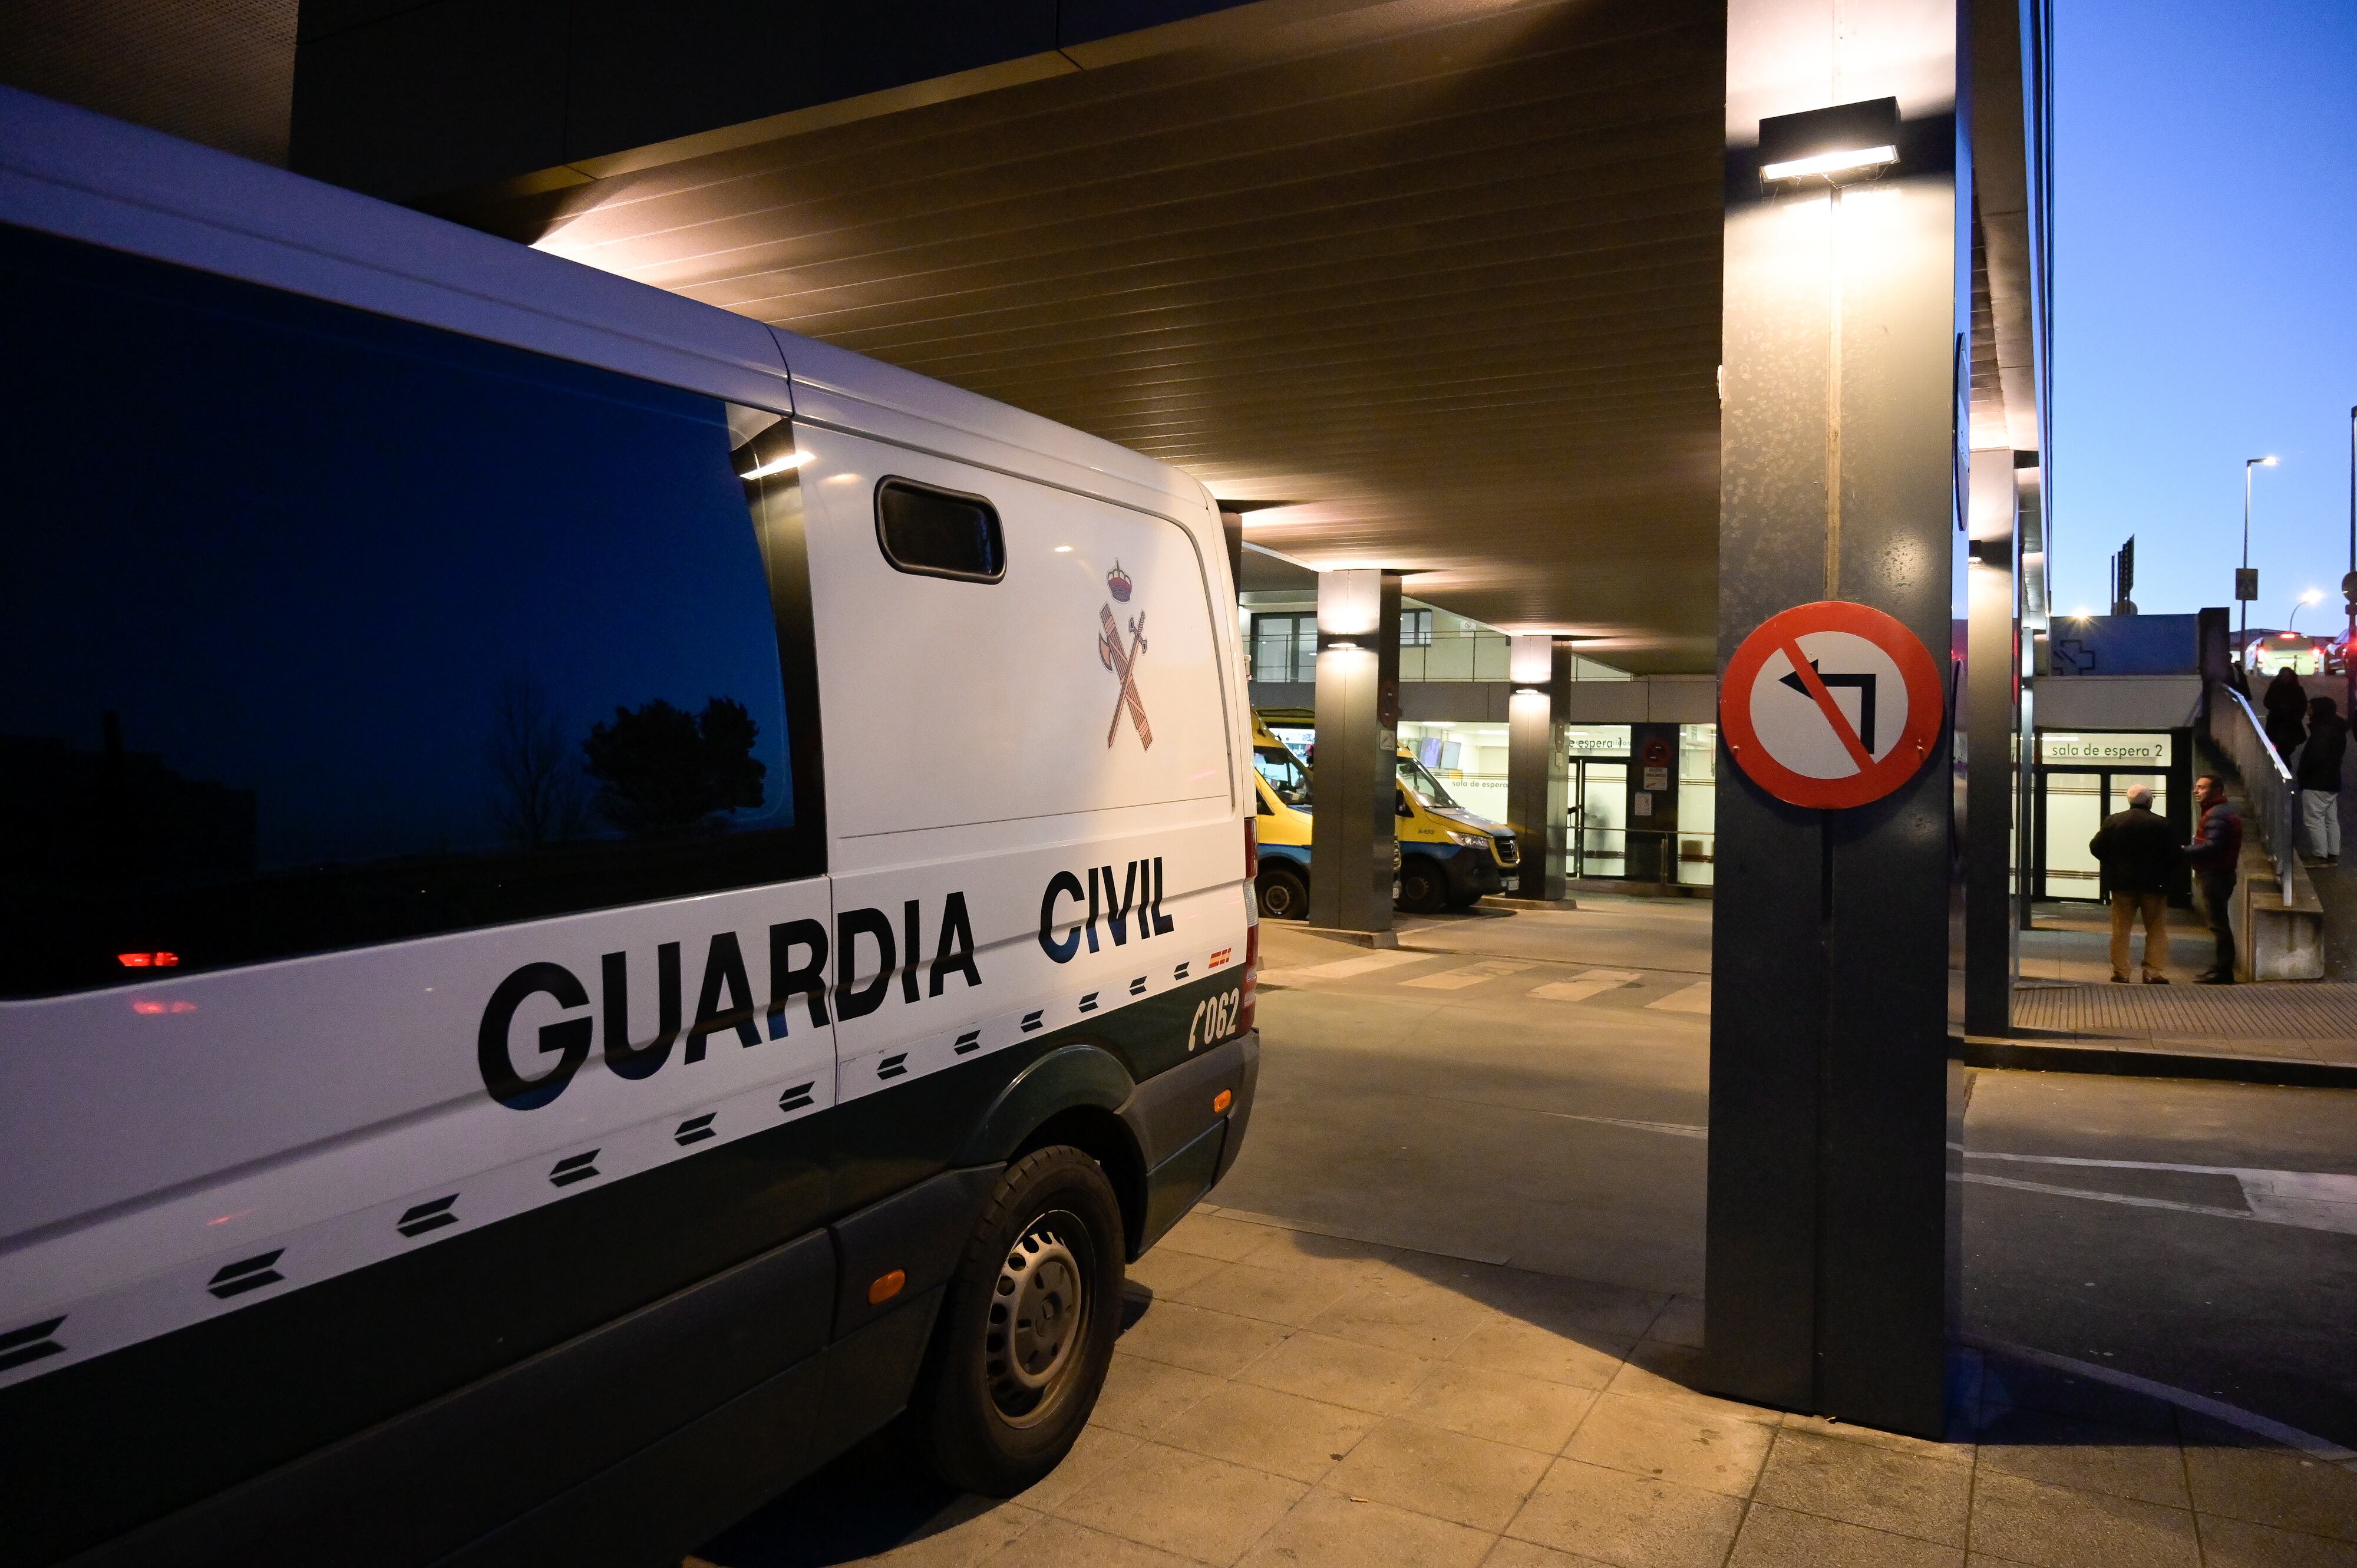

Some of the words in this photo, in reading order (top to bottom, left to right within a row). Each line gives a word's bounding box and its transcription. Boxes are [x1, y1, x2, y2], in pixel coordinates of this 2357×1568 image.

[1578, 740, 1612, 750] espera
[1618, 737, 1622, 748] 1
[2052, 744, 2078, 755] sala
[2084, 744, 2099, 756] de
[2105, 747, 2149, 759] espera
[2155, 744, 2163, 757] 2
[478, 892, 982, 1111] GUARDIA
[1039, 857, 1174, 964] CIVIL
[1204, 988, 1239, 1044] 062
